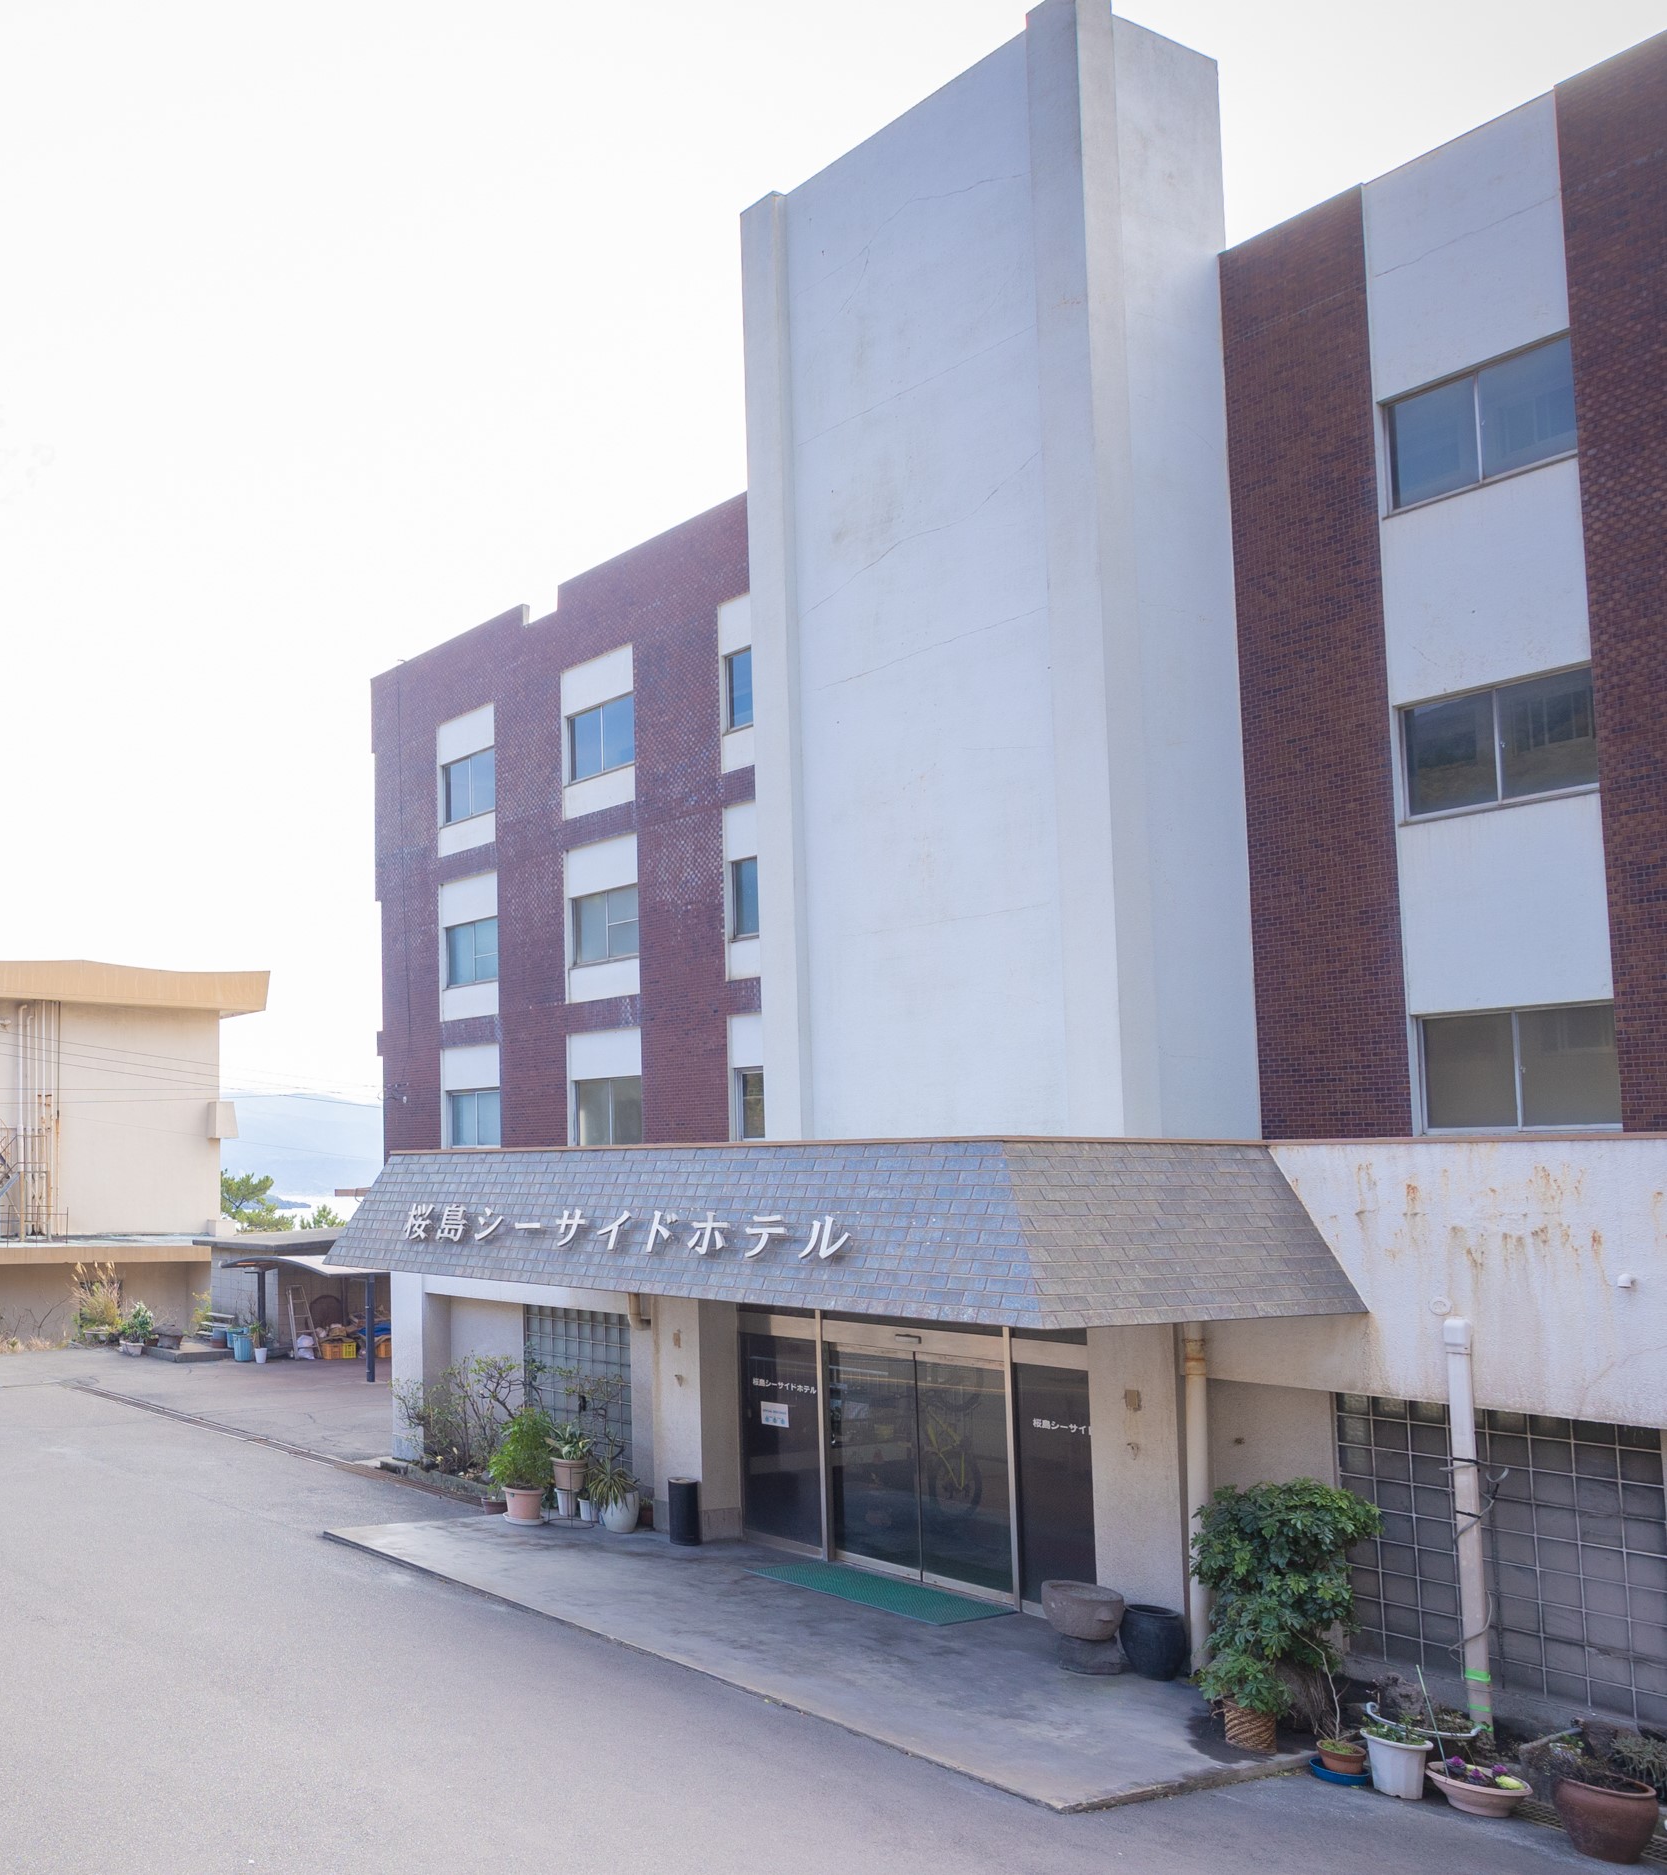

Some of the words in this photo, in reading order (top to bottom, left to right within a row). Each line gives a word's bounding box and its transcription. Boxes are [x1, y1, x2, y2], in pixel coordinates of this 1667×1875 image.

[403, 1202, 852, 1261] 桜島シーサイドホテル
[752, 1377, 817, 1395] 桜島シーサイドホテル
